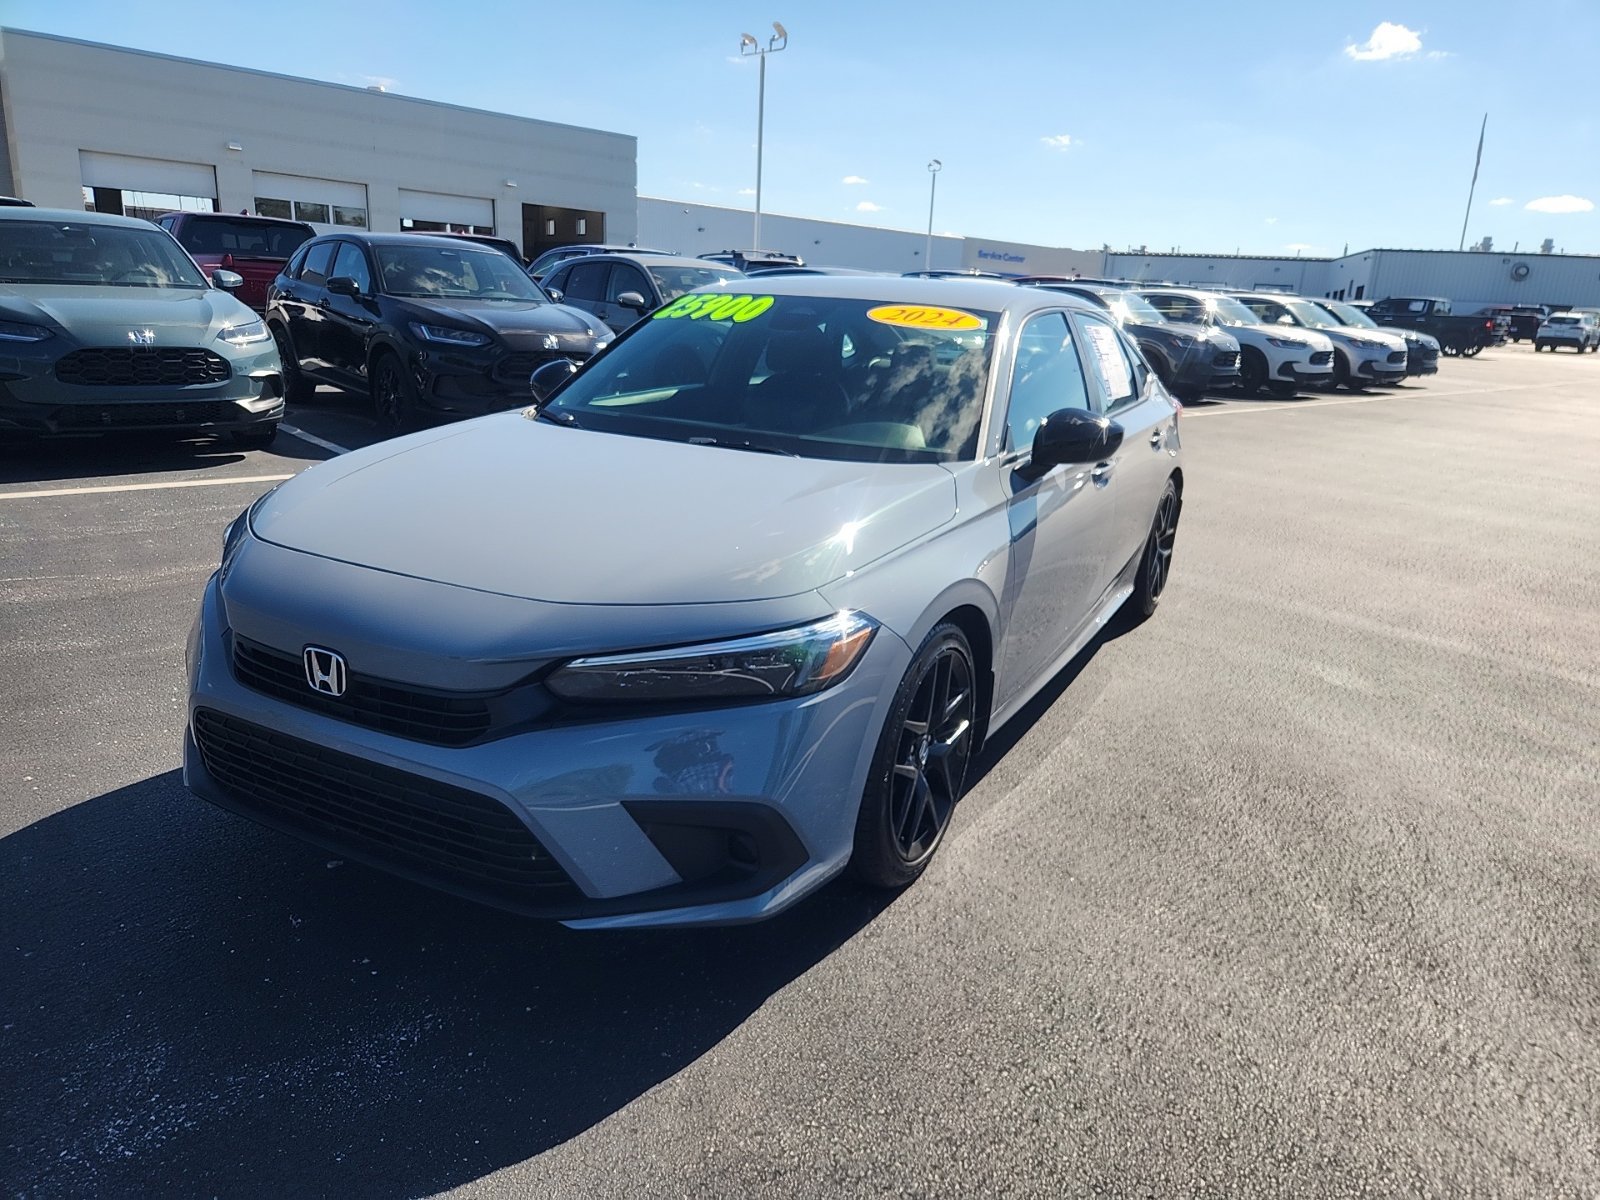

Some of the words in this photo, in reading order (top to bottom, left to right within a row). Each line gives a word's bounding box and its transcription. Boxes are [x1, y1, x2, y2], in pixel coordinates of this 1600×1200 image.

[978, 249, 1002, 261] Service
[1002, 252, 1026, 263] Center
[652, 294, 775, 323] 25900
[882, 309, 968, 326] 2024
